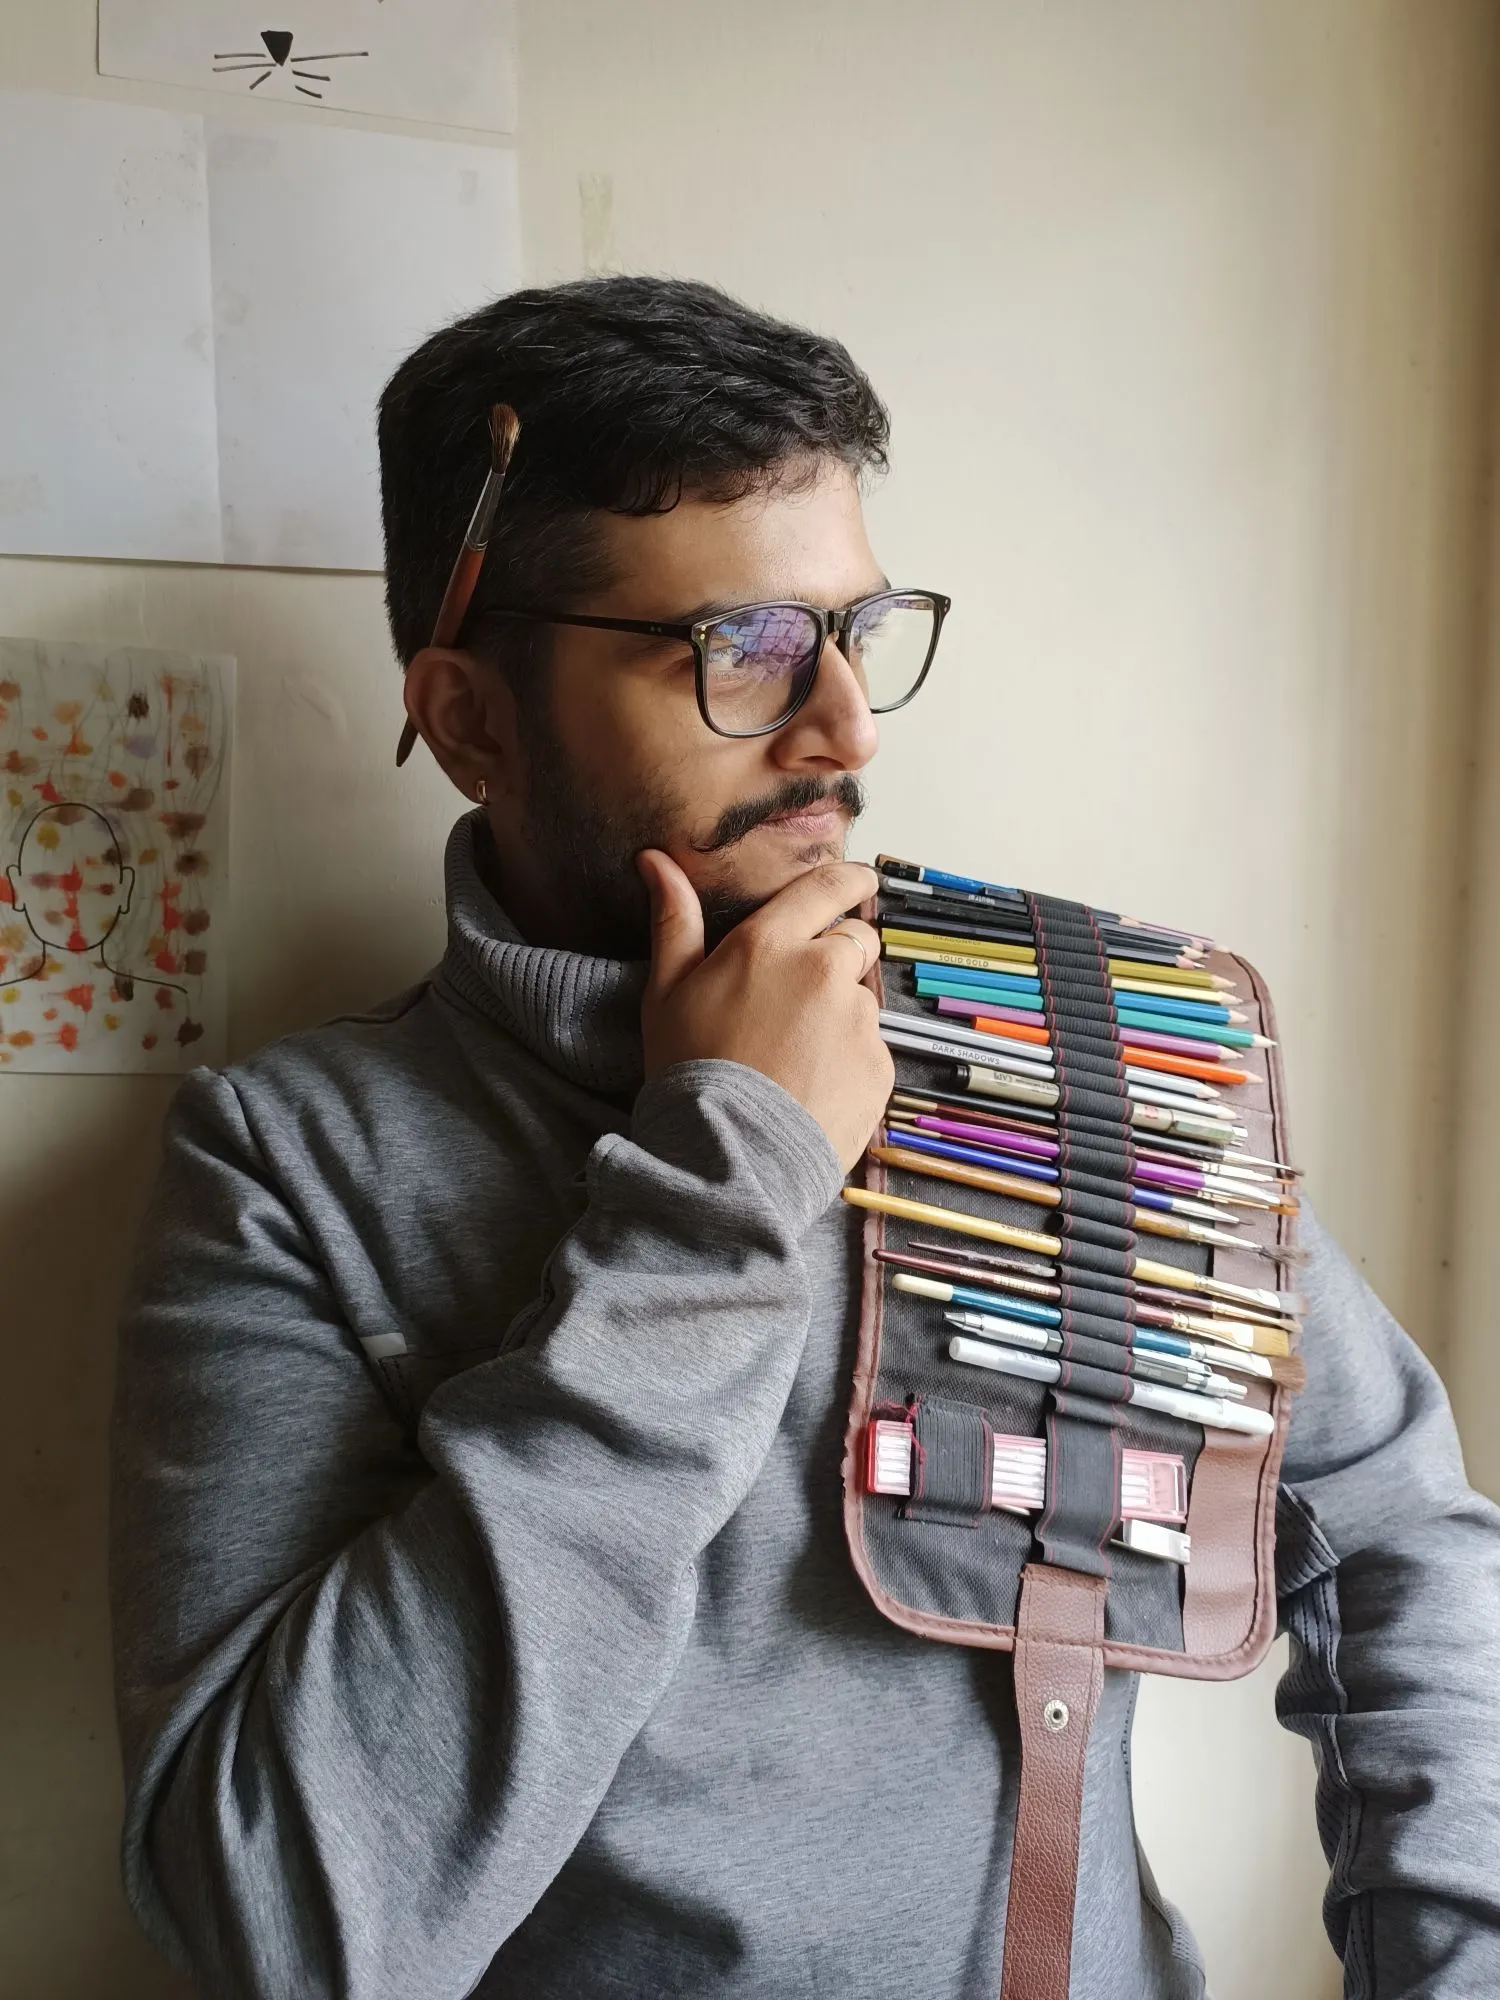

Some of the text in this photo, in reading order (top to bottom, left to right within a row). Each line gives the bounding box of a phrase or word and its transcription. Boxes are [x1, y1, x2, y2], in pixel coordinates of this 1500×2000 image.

[938, 954, 990, 968] SOLID GOLD
[931, 1042, 1001, 1066] DARK SHADOWS
